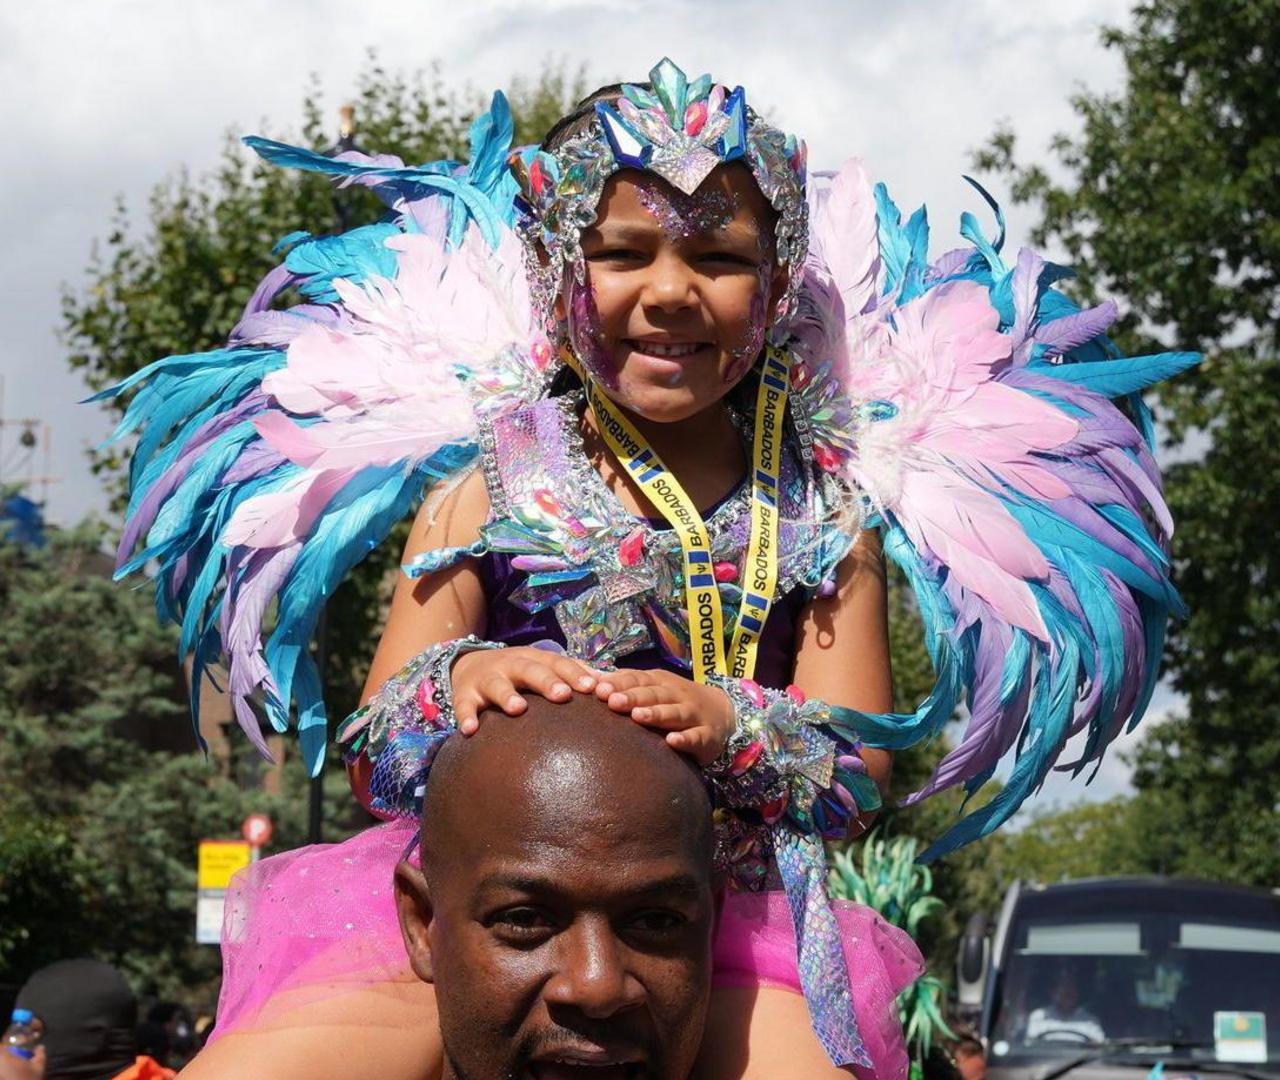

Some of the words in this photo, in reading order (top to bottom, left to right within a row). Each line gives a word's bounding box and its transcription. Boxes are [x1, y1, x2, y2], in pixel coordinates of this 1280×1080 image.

[594, 393, 641, 457] BARBADOS
[761, 390, 779, 470] BARBADOS
[652, 479, 703, 546] BARBADOS
[754, 505, 770, 591] BARBADOS
[698, 592, 716, 680] ARBADOS
